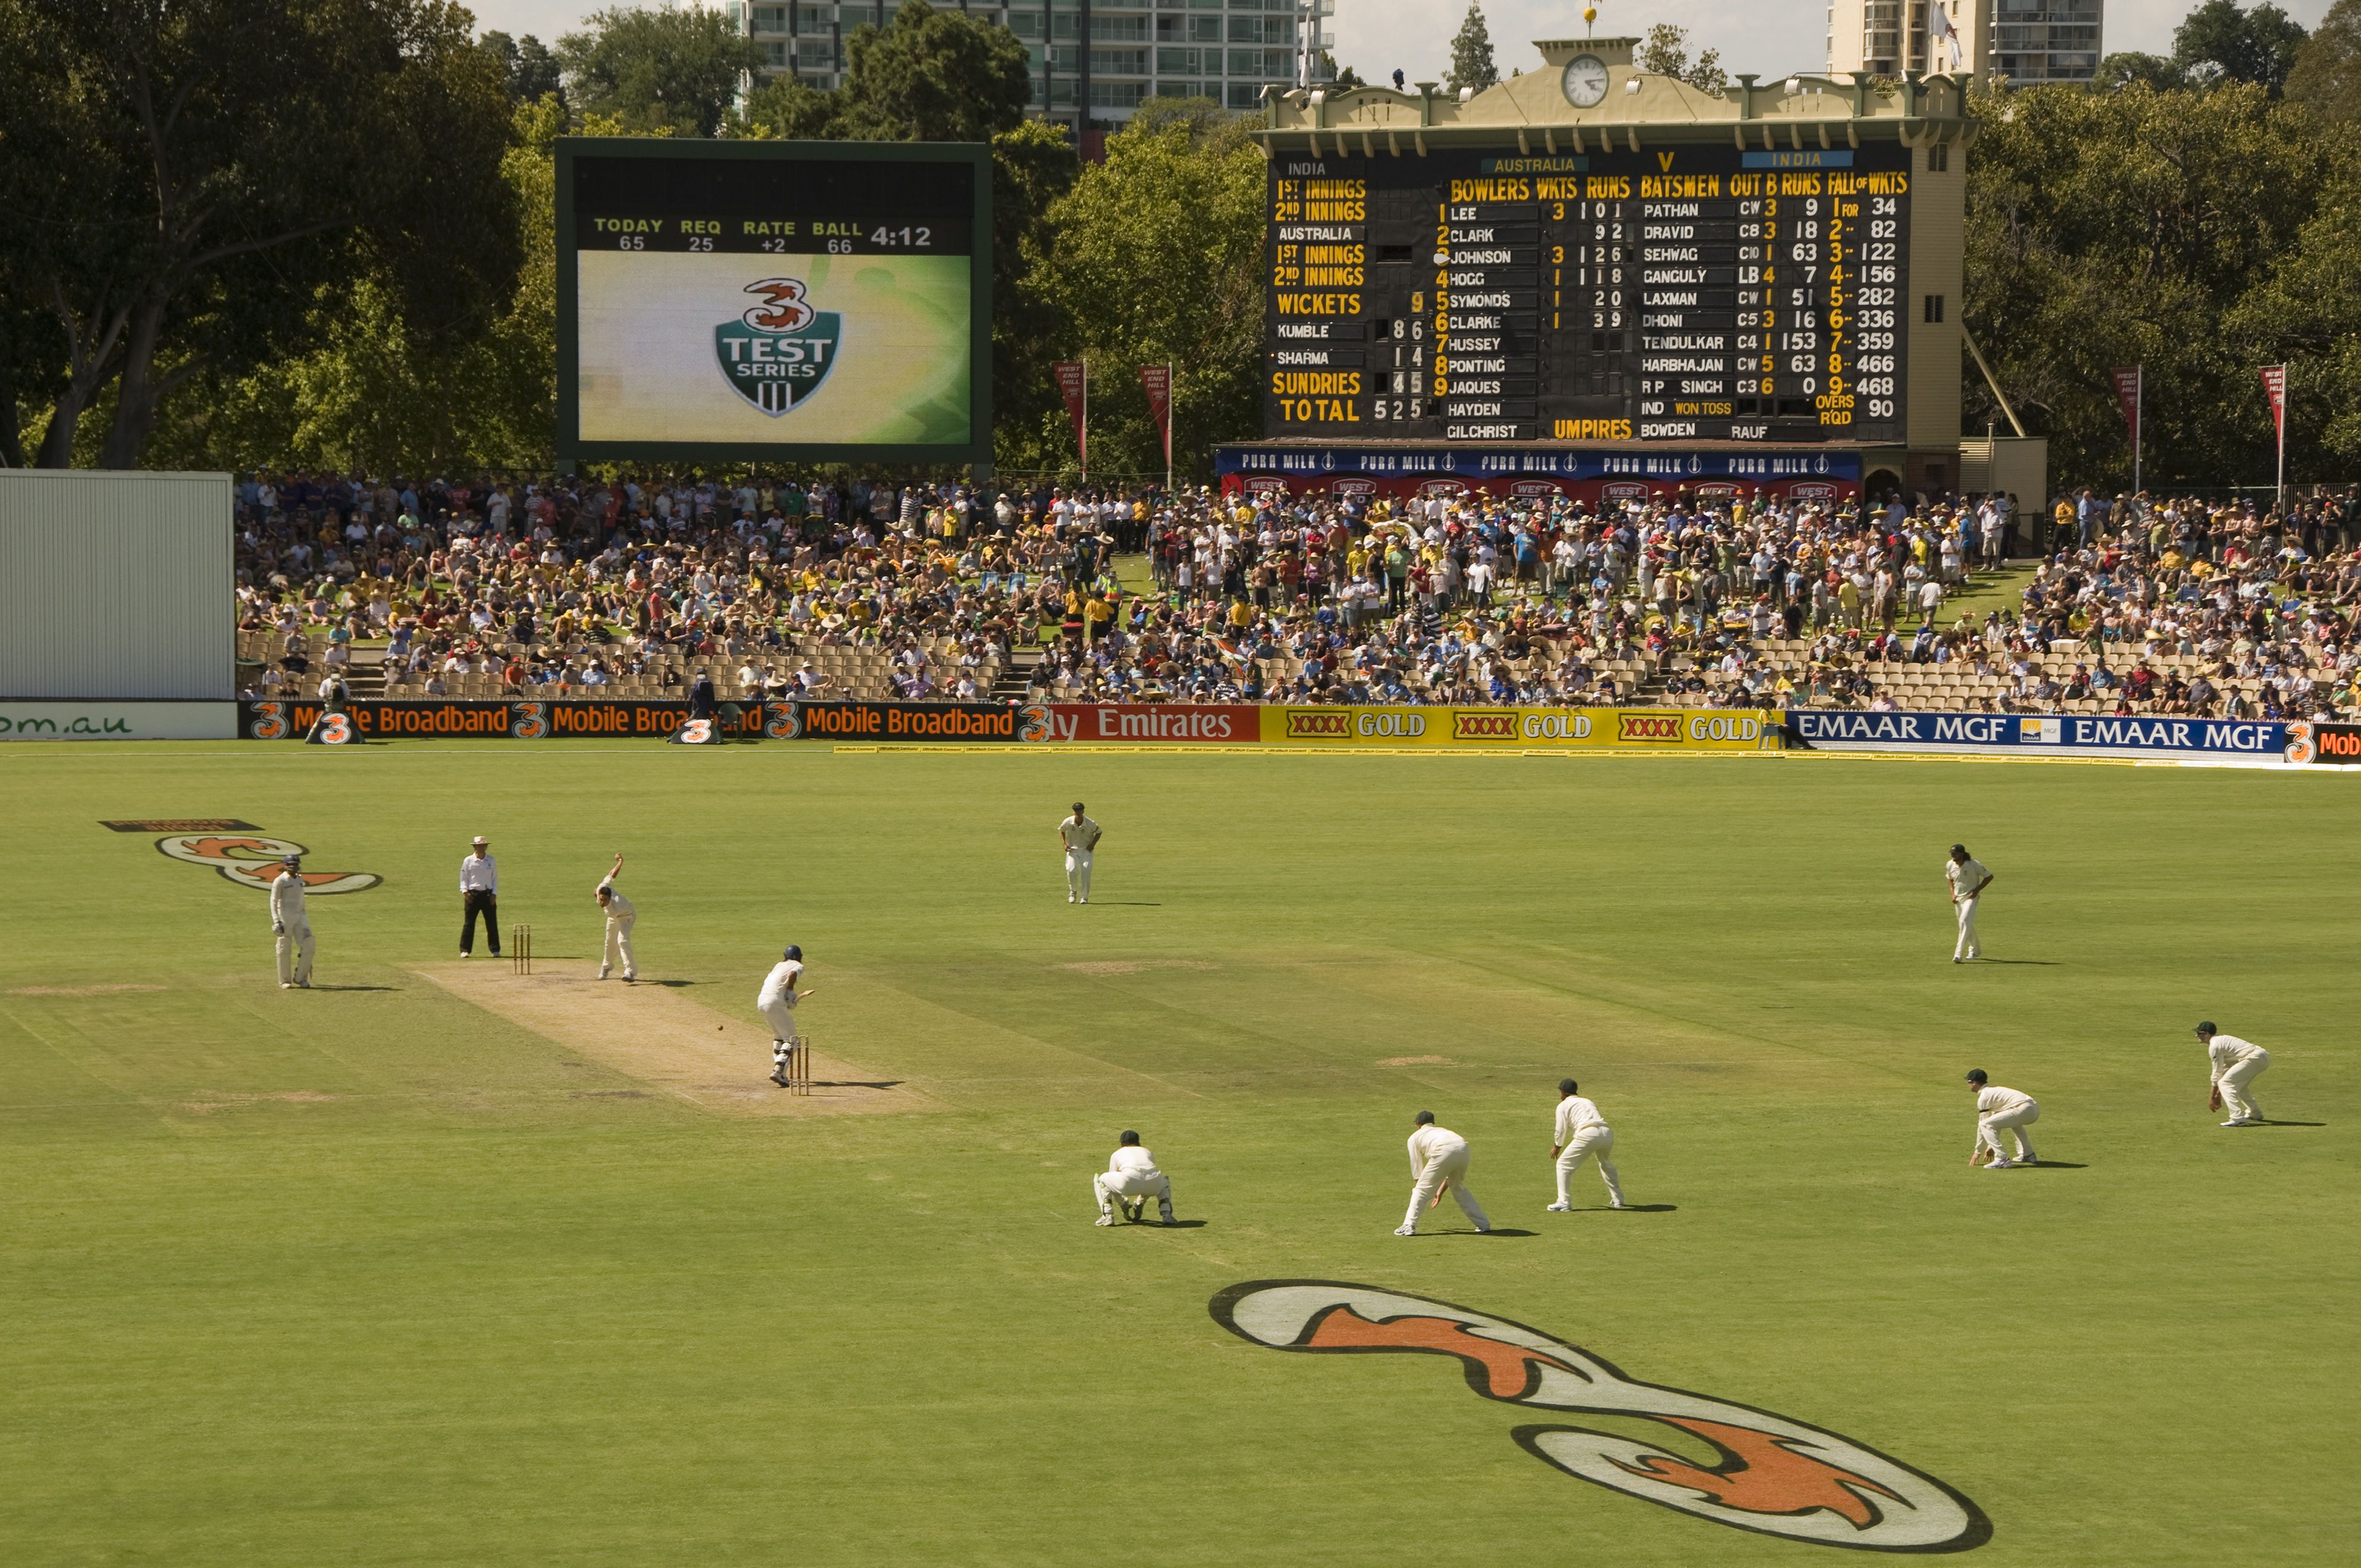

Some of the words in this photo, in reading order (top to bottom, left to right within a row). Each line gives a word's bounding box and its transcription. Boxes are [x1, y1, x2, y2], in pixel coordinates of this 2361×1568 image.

[1494, 159, 1575, 172] AUSTRALIA
[1658, 152, 1674, 172] V
[1773, 153, 1821, 166] INDIA
[1288, 163, 1325, 175] INDIA
[1278, 180, 1299, 200] 1ST
[1306, 179, 1366, 199] INNINGS
[1451, 178, 1529, 202] BOWLERS
[1537, 177, 1578, 200] WKTS
[1587, 176, 1630, 198] RUNS
[1641, 175, 1719, 197] BATSMEN
[1730, 174, 1761, 196] OUT
[1782, 173, 1821, 195] RUNS
[1828, 173, 1856, 195] FALL
[1856, 177, 1867, 189] OF
[1868, 172, 1907, 194] WKTS
[1275, 203, 1300, 222] 2ND
[1306, 201, 1366, 221] INNINGS
[1451, 207, 1477, 220] LEE
[1645, 204, 1699, 217] PATHAN
[1740, 201, 1761, 214] CW
[1842, 204, 1859, 217] FOR
[1872, 198, 1895, 215] 34
[595, 218, 663, 233] TODAY
[681, 220, 721, 235] REQ
[744, 222, 795, 235] RATE
[813, 222, 862, 236] BALL
[871, 227, 931, 246] 4:12
[1279, 227, 1352, 241] AUSTRALIA
[1450, 229, 1494, 242] CLARK
[1644, 226, 1693, 239] DRAVID
[1739, 224, 1759, 238] C8
[1796, 221, 1818, 238] 18
[1871, 221, 1895, 238] 82
[620, 236, 644, 251] 65
[689, 238, 713, 252] 25
[761, 239, 785, 252] +2
[828, 239, 852, 254] 66
[1644, 248, 1698, 261] SEHWAG
[1739, 246, 1759, 260] C10
[1792, 244, 1817, 261] 63
[1861, 244, 1895, 261] 122
[1277, 245, 1298, 264] 1ST
[1305, 245, 1364, 264] INNINGS
[1450, 250, 1510, 264] JOHNSON
[1274, 267, 1300, 286] 2ND
[1305, 267, 1364, 286] INNINGS
[1450, 272, 1484, 285] HOGG
[1643, 269, 1706, 283] GANGULY
[1739, 267, 1759, 280] LB
[1861, 266, 1895, 283] 156
[1278, 294, 1361, 314] WICKETS
[1411, 293, 1423, 312] 9
[1450, 294, 1510, 308] SYMONDS
[1643, 292, 1697, 305] LAXMAN
[1738, 291, 1759, 305] CW
[1792, 289, 1813, 306] 51
[1858, 288, 1895, 305] 282
[1450, 315, 1501, 329] CLARKE
[1642, 314, 1683, 327] DHONI
[1737, 313, 1758, 326] C5
[1795, 311, 1816, 328] 16
[1857, 309, 1895, 327] 336
[1278, 325, 1329, 338] KUMBLE
[1449, 337, 1500, 350] HUSSEY
[1643, 336, 1724, 350] TENDULKAR
[1737, 336, 1758, 349] C4
[1782, 333, 1816, 350] 153
[1857, 332, 1894, 350] 359
[723, 338, 832, 362] TEST
[1277, 352, 1329, 365] SHARMA
[737, 364, 816, 377] SERIES
[1449, 359, 1505, 372] PONTING
[1642, 358, 1723, 372] HARBHAJAN
[1737, 358, 1758, 371] CW
[1791, 355, 1816, 372] 63
[1857, 355, 1894, 372] 466
[1273, 372, 1360, 395] SUNDRIES
[1449, 381, 1500, 394] JAQUES
[1642, 381, 1651, 394] R
[1655, 381, 1664, 394] P
[1682, 380, 1722, 393] SINGH
[1737, 380, 1758, 393] C3
[1856, 377, 1894, 395] 468
[1281, 399, 1360, 421] TOTAL
[1448, 403, 1500, 416] HAYDEN
[1642, 402, 1664, 415] IND
[1675, 402, 1699, 415] WON
[1702, 402, 1731, 415] TOSS
[1816, 394, 1854, 409] OVERS
[1869, 400, 1894, 417] 90
[1447, 425, 1518, 438] GILCHRIST
[1555, 419, 1632, 439] UMPIRES
[1641, 423, 1695, 437] BOWDEN
[1731, 426, 1768, 439] RAUF
[1242, 454, 1276, 469] PURA
[1284, 454, 1315, 469] MILK
[1361, 456, 1395, 470] PURA
[1402, 456, 1436, 470] MILK
[1482, 456, 1515, 470] PURA
[1524, 456, 1557, 471] MILK
[1604, 458, 1639, 472] PURA
[1647, 458, 1681, 473] MILK
[1729, 459, 1765, 473] PURA
[1773, 459, 1808, 473] MILK
[1339, 483, 1370, 492] WEST
[1609, 486, 1642, 495] WEST
[1797, 487, 1831, 496] WEST
[380, 706, 507, 732] Broadband
[554, 706, 628, 732] Mobile
[807, 708, 880, 733] Mobile
[889, 709, 1013, 735] Broadband
[1098, 708, 1231, 737] Emirates
[1292, 716, 1348, 733] XXXX
[1358, 713, 1426, 736] GOLD
[1459, 717, 1513, 734] XXXX
[1524, 714, 1592, 738] GOLD
[1624, 719, 1679, 736] XXXX
[1690, 716, 1759, 741] GOLD
[1799, 715, 1922, 739] EMAAR
[1935, 718, 2006, 741] MGF
[2075, 720, 2192, 746] EMAAR
[2204, 725, 2272, 749] MGF
